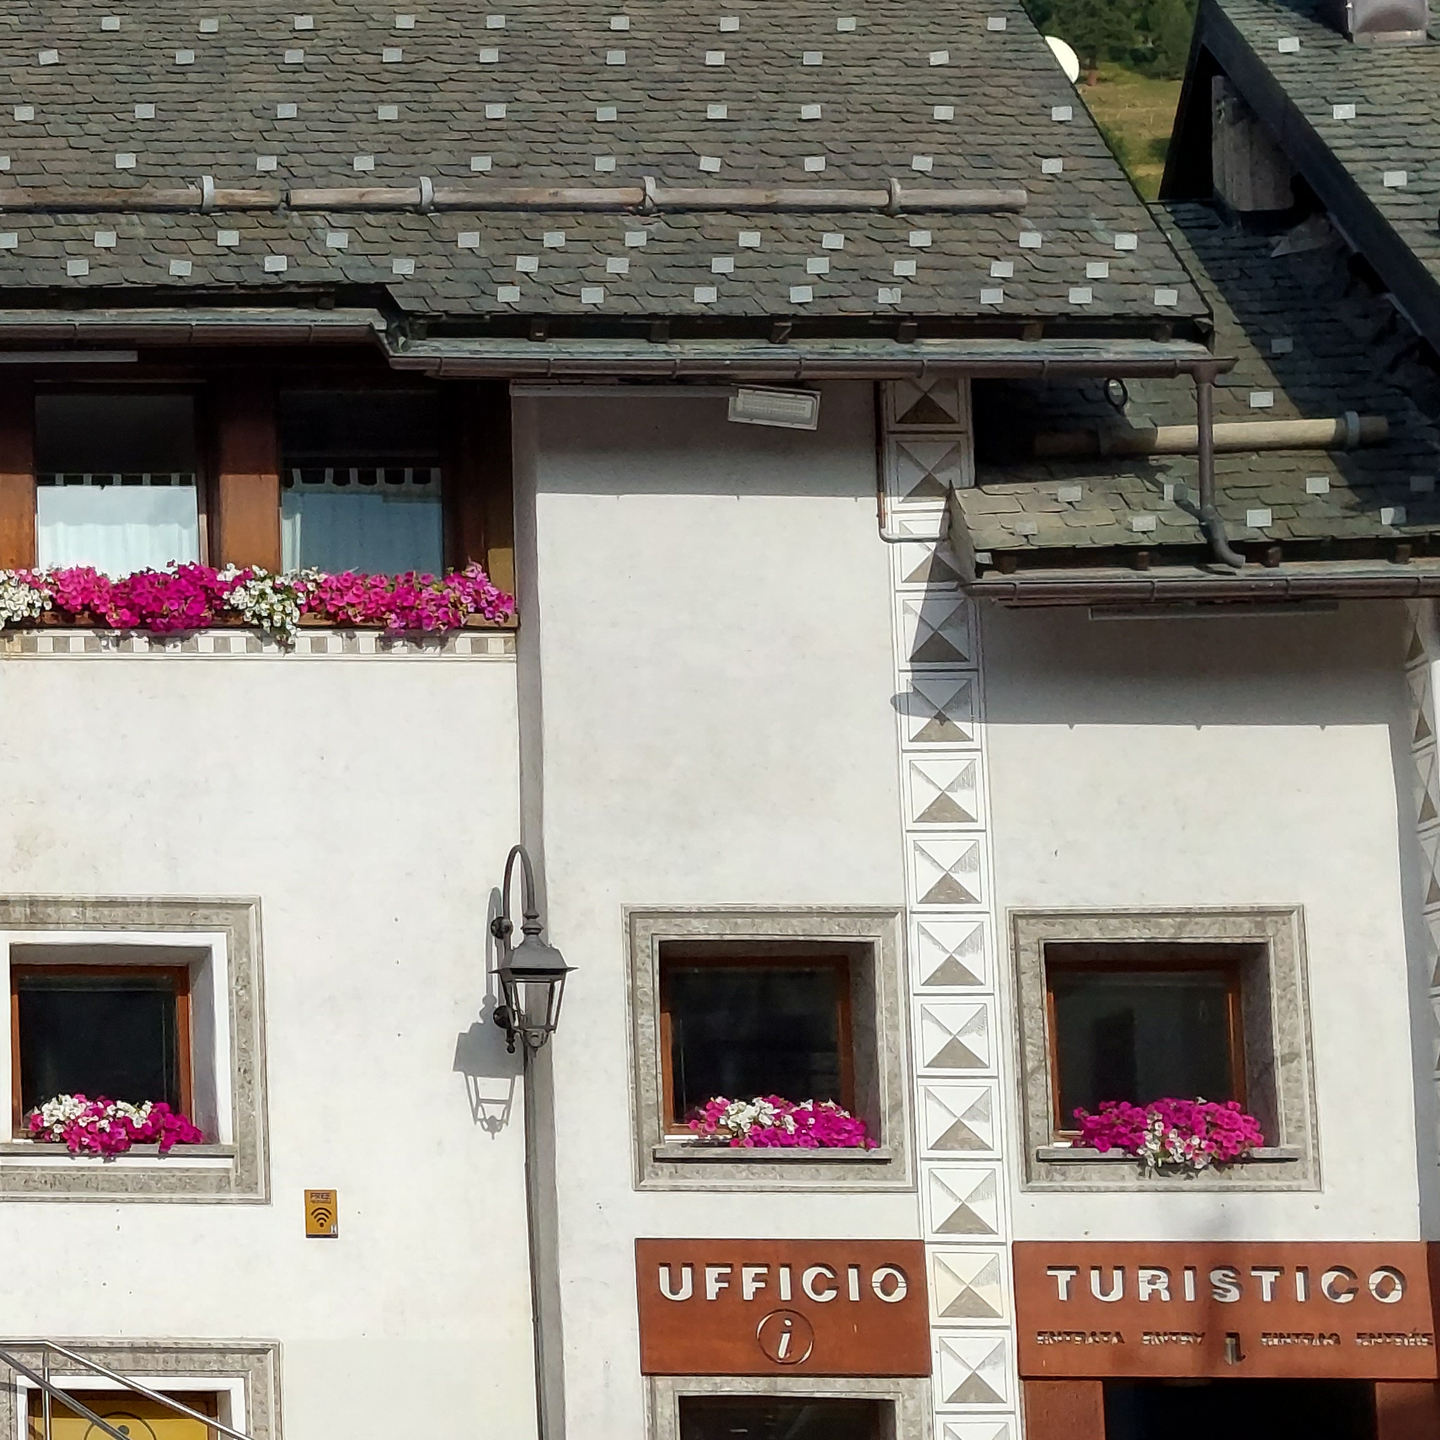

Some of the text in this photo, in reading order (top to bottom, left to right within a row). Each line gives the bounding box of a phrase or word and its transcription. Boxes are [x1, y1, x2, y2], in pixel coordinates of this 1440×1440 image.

[658, 1263, 908, 1303] UFFICIO
[1046, 1265, 1407, 1304] TURISTICO
[1037, 1331, 1125, 1345] ENTRATA
[1142, 1331, 1206, 1345] ENTRY
